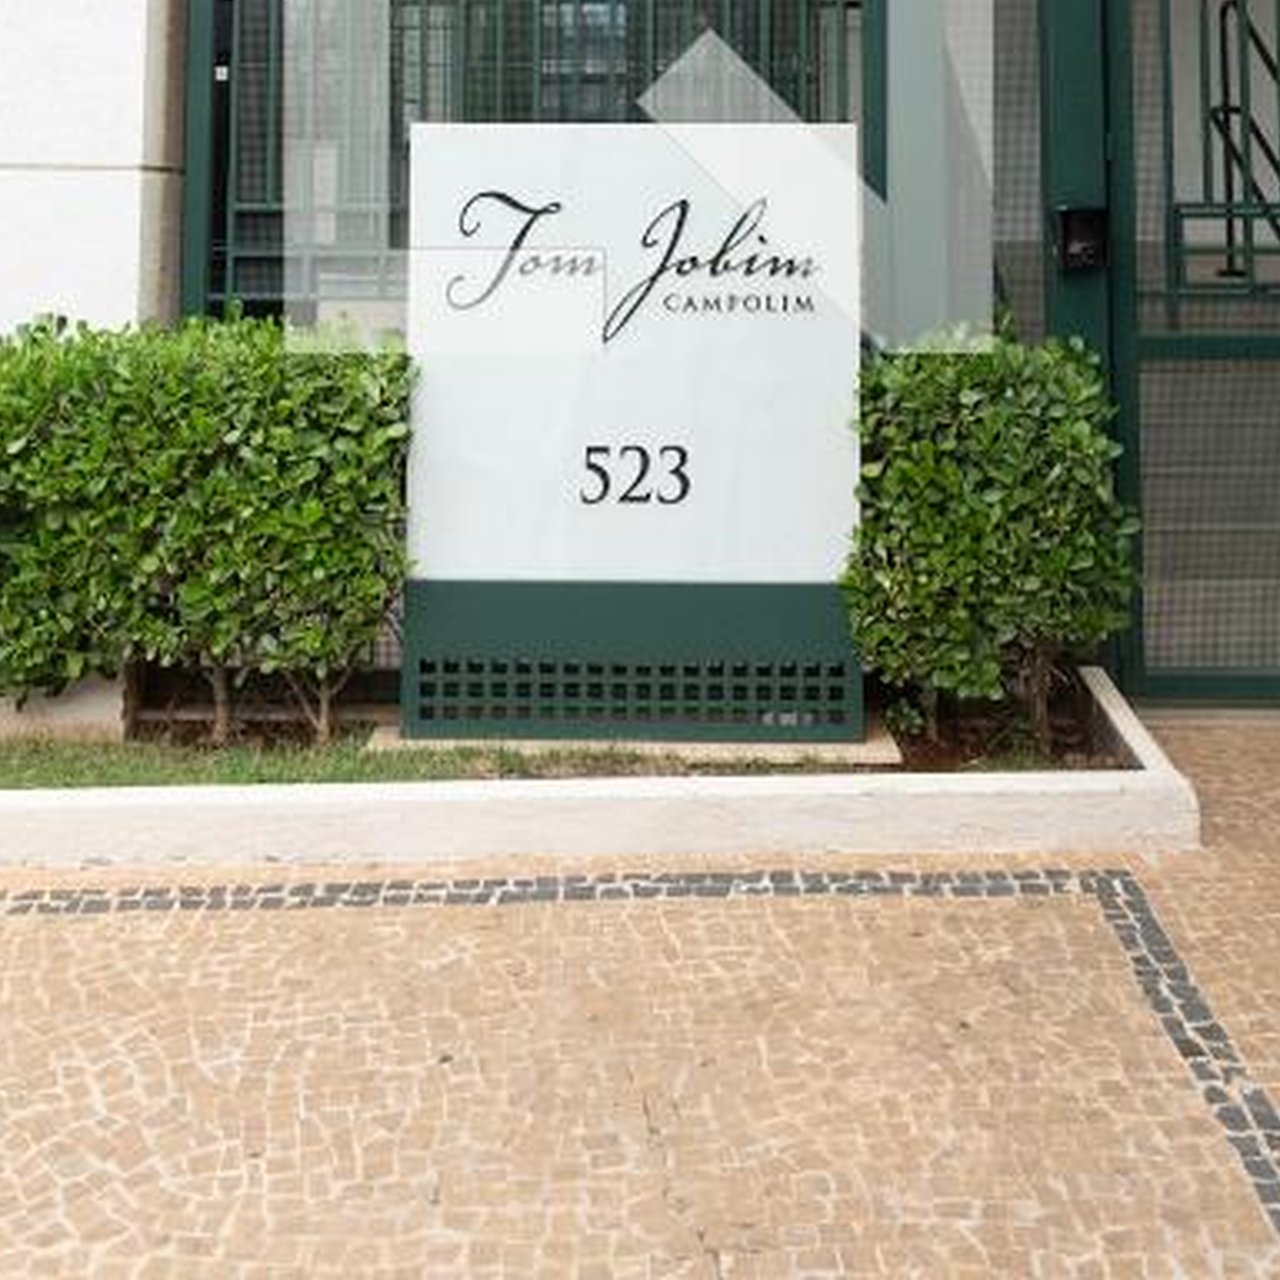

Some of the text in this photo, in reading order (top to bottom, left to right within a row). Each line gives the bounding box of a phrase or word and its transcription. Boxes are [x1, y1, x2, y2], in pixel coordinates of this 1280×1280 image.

[446, 191, 818, 343] Tom Jobim
[662, 293, 816, 314] CAMPOLIM
[580, 445, 692, 505] 523
